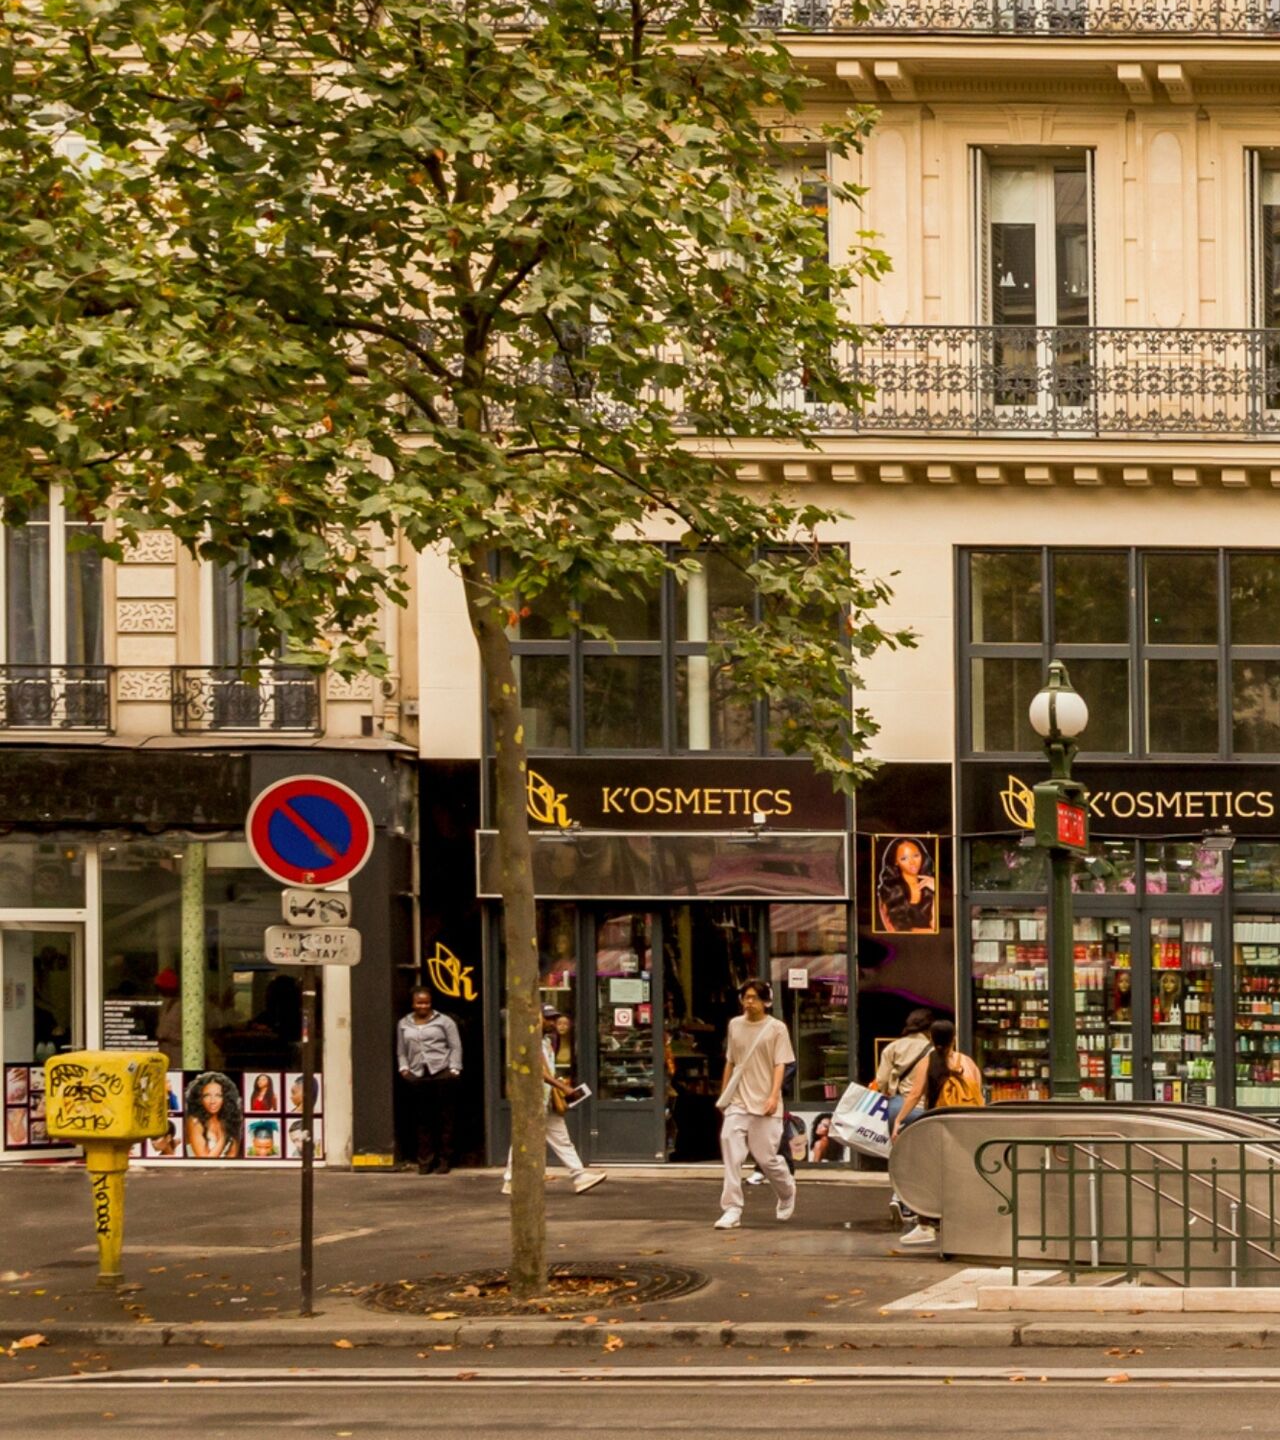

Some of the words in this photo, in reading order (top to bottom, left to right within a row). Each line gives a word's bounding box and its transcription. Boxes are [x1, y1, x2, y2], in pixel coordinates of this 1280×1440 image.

[602, 787, 792, 815] K'OSMETICS
[1084, 791, 1274, 818] K'OSMETICS
[856, 1126, 889, 1145] ACTION
